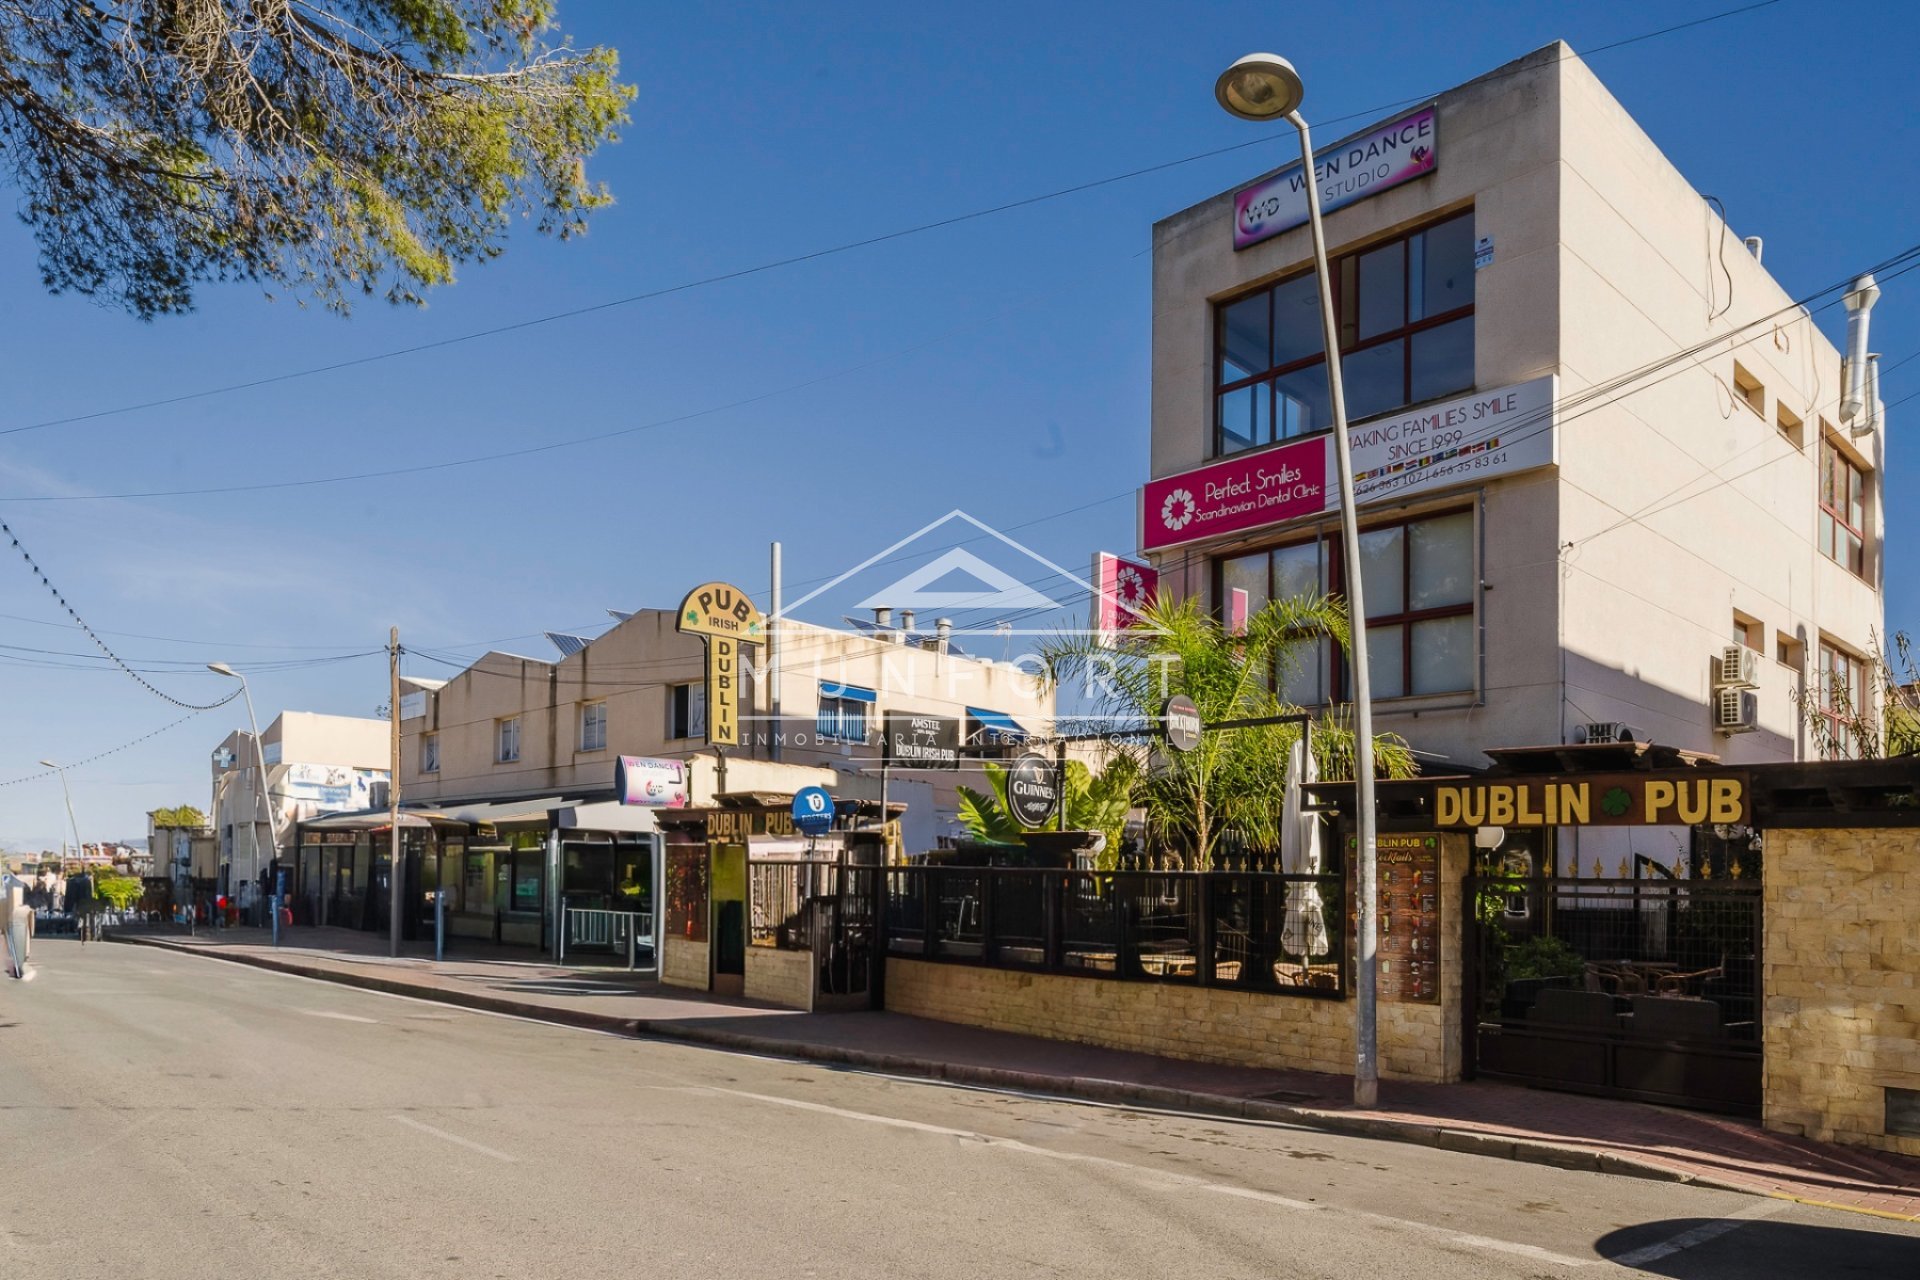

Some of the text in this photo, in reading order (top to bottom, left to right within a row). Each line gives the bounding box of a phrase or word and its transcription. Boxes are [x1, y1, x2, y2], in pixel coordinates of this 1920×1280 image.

[1349, 117, 1431, 168] DANCE
[1325, 163, 1390, 201] STUDIO
[1402, 407, 1467, 437] FAMILIES
[1472, 393, 1517, 420] SMILE
[1388, 430, 1462, 461] SINCE 1999
[1493, 452, 1507, 464] 61
[1205, 464, 1301, 502] Perfect Smiles
[1195, 484, 1320, 522] Scandinavian Dental Clinic
[698, 588, 750, 622] PUB
[709, 616, 738, 631] IRISH
[718, 641, 731, 740] DUBLIN
[941, 748, 955, 761] PUB
[1437, 779, 1743, 827] DUBLIN PUB
[707, 812, 794, 836] DUBLIN PUB
[1377, 838, 1420, 848] BLIN PUB
